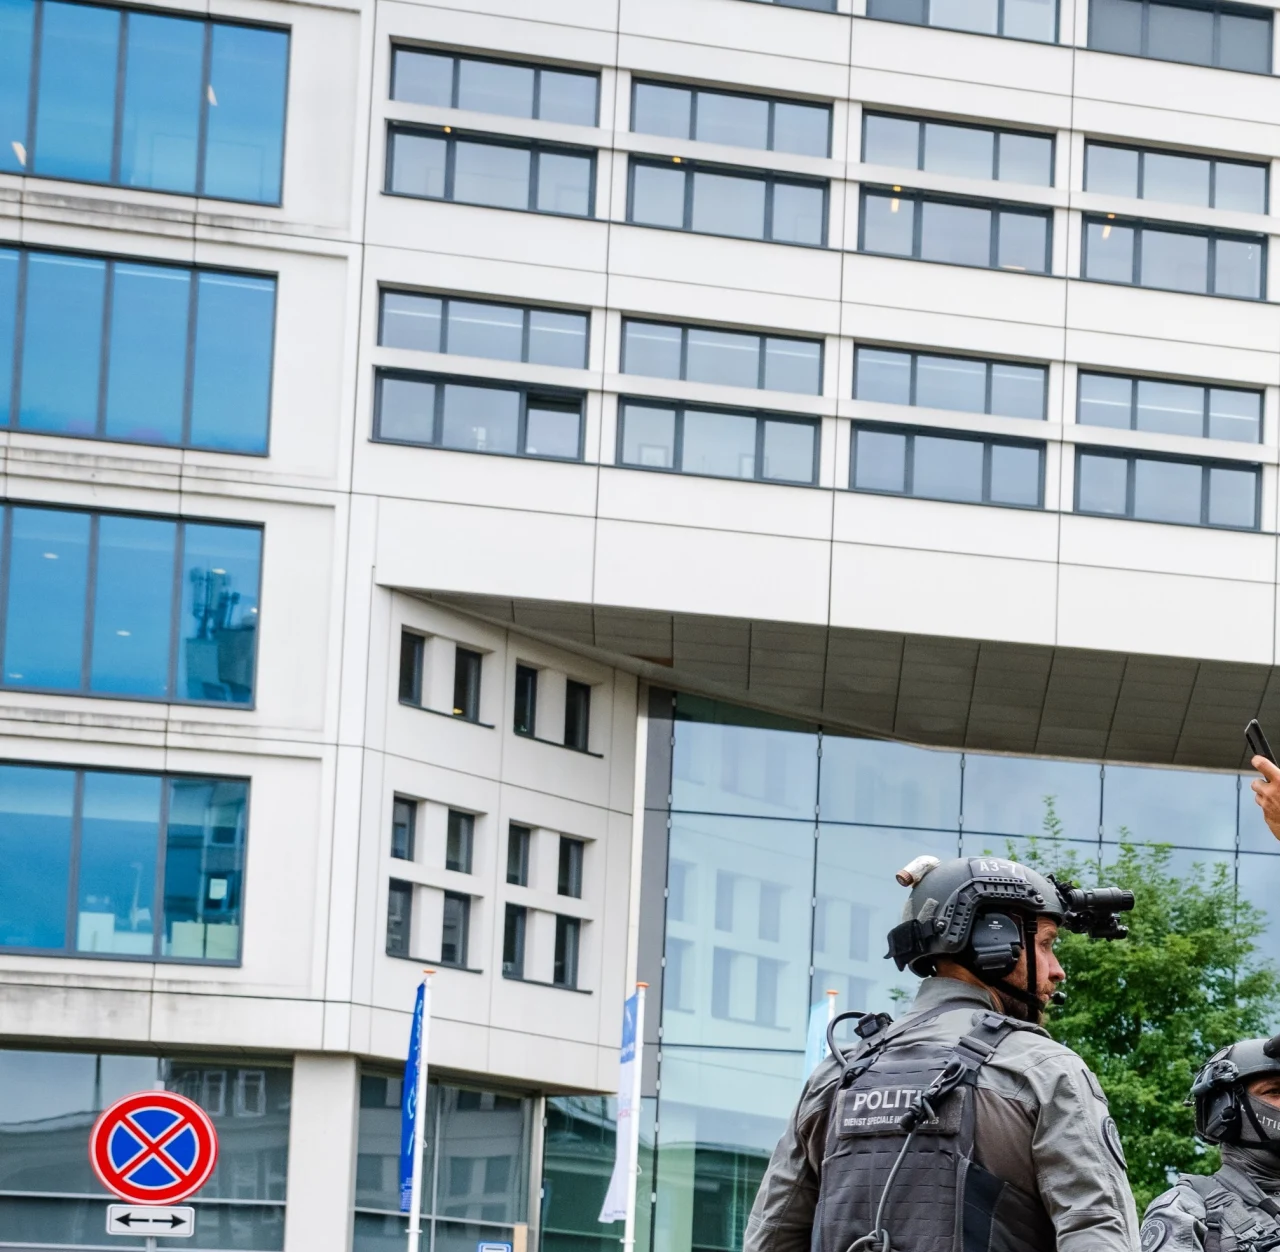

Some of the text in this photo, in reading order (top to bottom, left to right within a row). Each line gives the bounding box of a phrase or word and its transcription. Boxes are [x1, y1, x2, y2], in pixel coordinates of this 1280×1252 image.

[980, 861, 1016, 874] A3-7
[853, 1089, 922, 1111] POLIT
[844, 1117, 867, 1127] DIENST
[867, 1115, 894, 1126] SPECIALE
